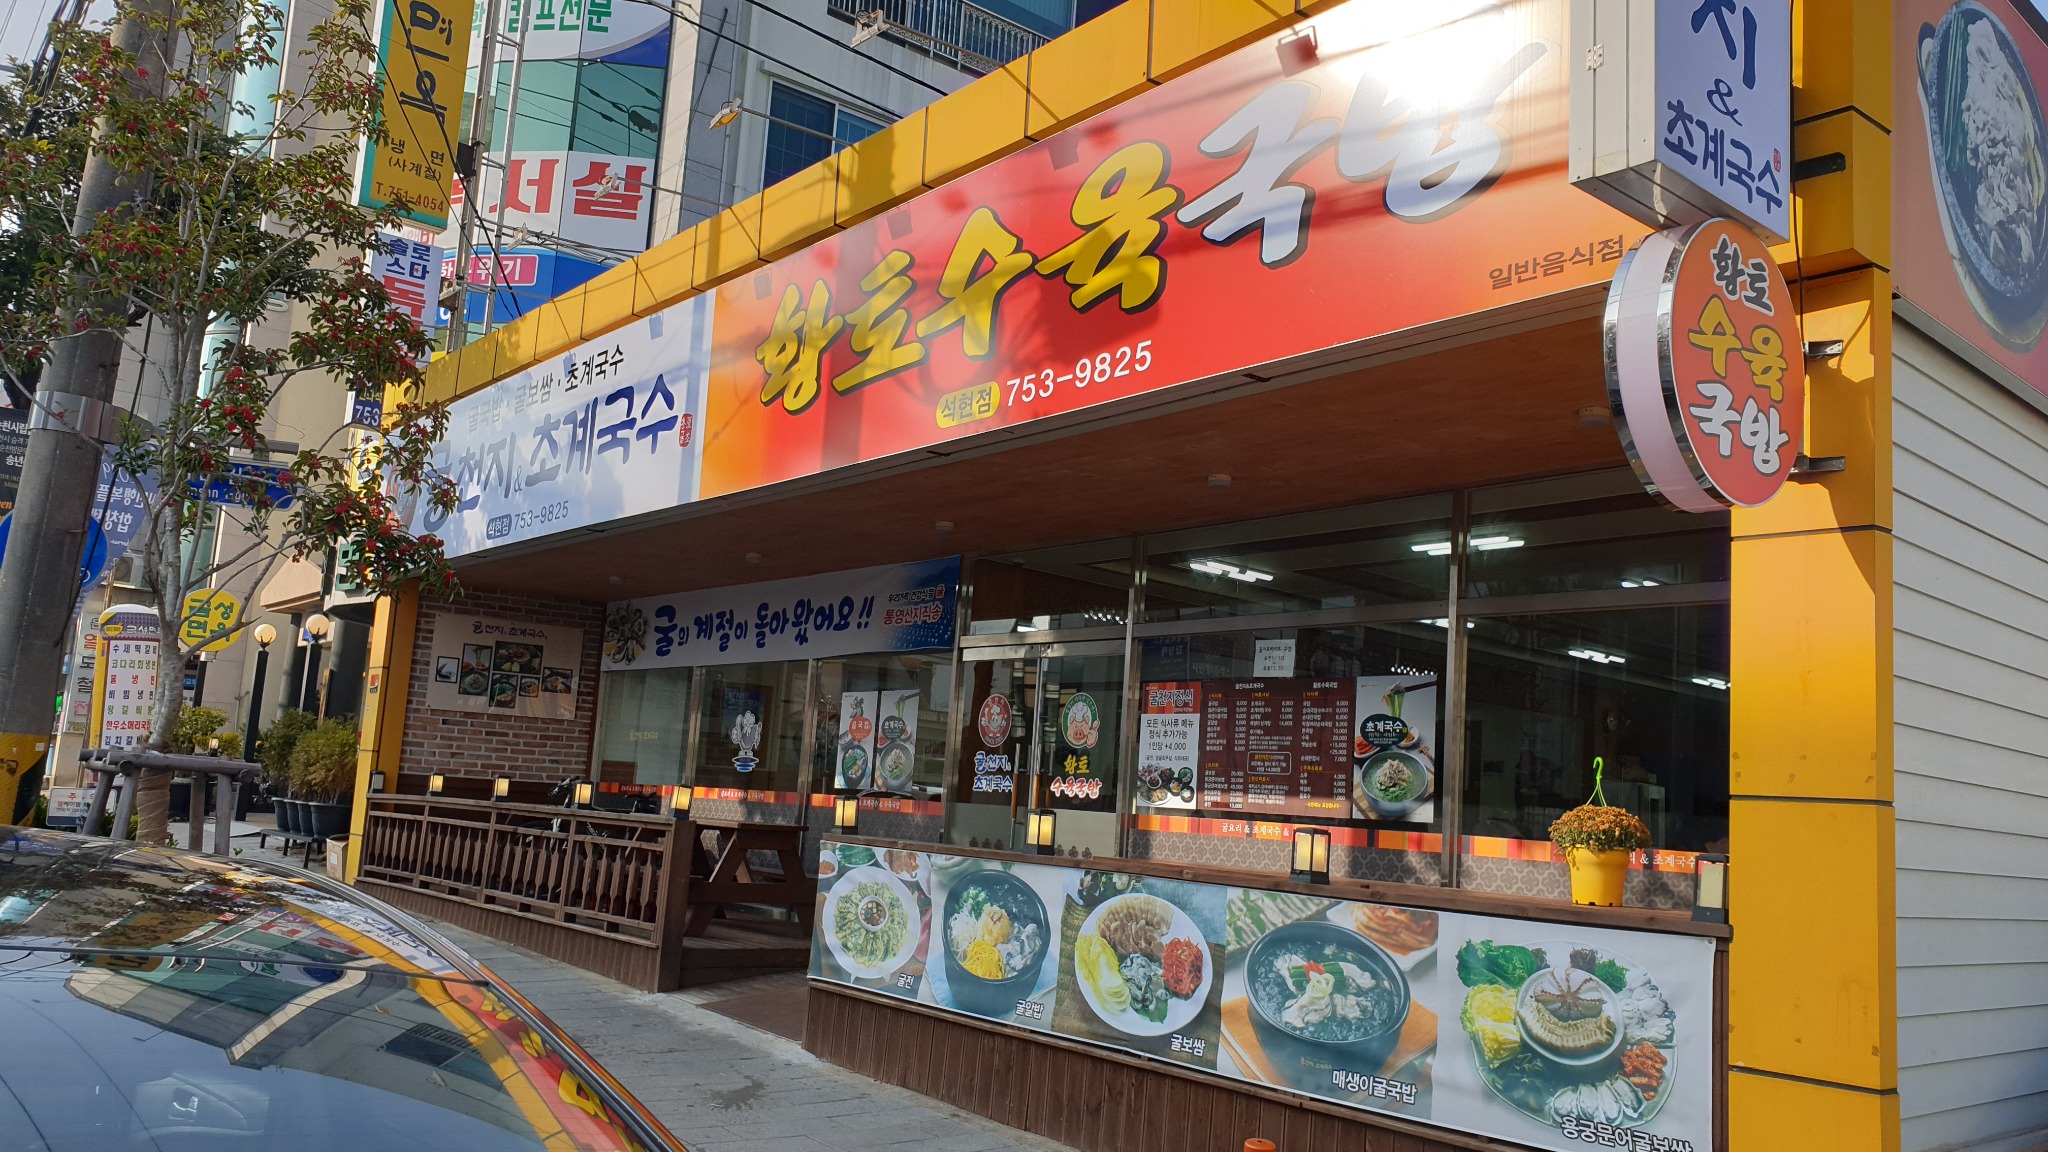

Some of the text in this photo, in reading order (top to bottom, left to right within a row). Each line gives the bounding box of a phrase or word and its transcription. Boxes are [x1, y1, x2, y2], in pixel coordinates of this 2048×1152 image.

[388, 156, 442, 181] (사계절)
[1663, 99, 1783, 215] 초계국수
[1487, 234, 1627, 291] 일반음식점
[1710, 234, 1774, 316] 황토
[1688, 296, 1788, 402] 수육
[564, 344, 625, 392] 초계국수
[1004, 341, 1153, 407] 753-9825
[939, 386, 997, 426] 석현점
[524, 373, 679, 488] 초계국수
[1689, 380, 1790, 475] 국밥
[487, 501, 569, 539] 석현점 753-9825
[884, 602, 942, 625] 통영산지직송
[654, 604, 690, 656] 굴의
[694, 609, 748, 653] 계절이
[1149, 689, 1195, 707] 굴천지정식
[1146, 719, 1194, 728] 모든 식사류 메뉴
[1149, 730, 1188, 739] 정식 추가가능
[1365, 720, 1403, 733] 초계국수
[1148, 741, 1163, 750] 1인당
[974, 751, 1008, 773] 굴천지
[1064, 754, 1090, 775] 황토
[973, 775, 1013, 792] 초계국수
[1050, 776, 1102, 800] 수육국밥
[1221, 822, 1290, 838] 굴요리 & 초계국수 &
[1640, 854, 1649, 866] &
[897, 973, 915, 989] 굴전
[1015, 999, 1045, 1020] 굴알밥
[1170, 1033, 1206, 1057] 굴보쌈
[1331, 1069, 1418, 1105] 매생이굴국밥
